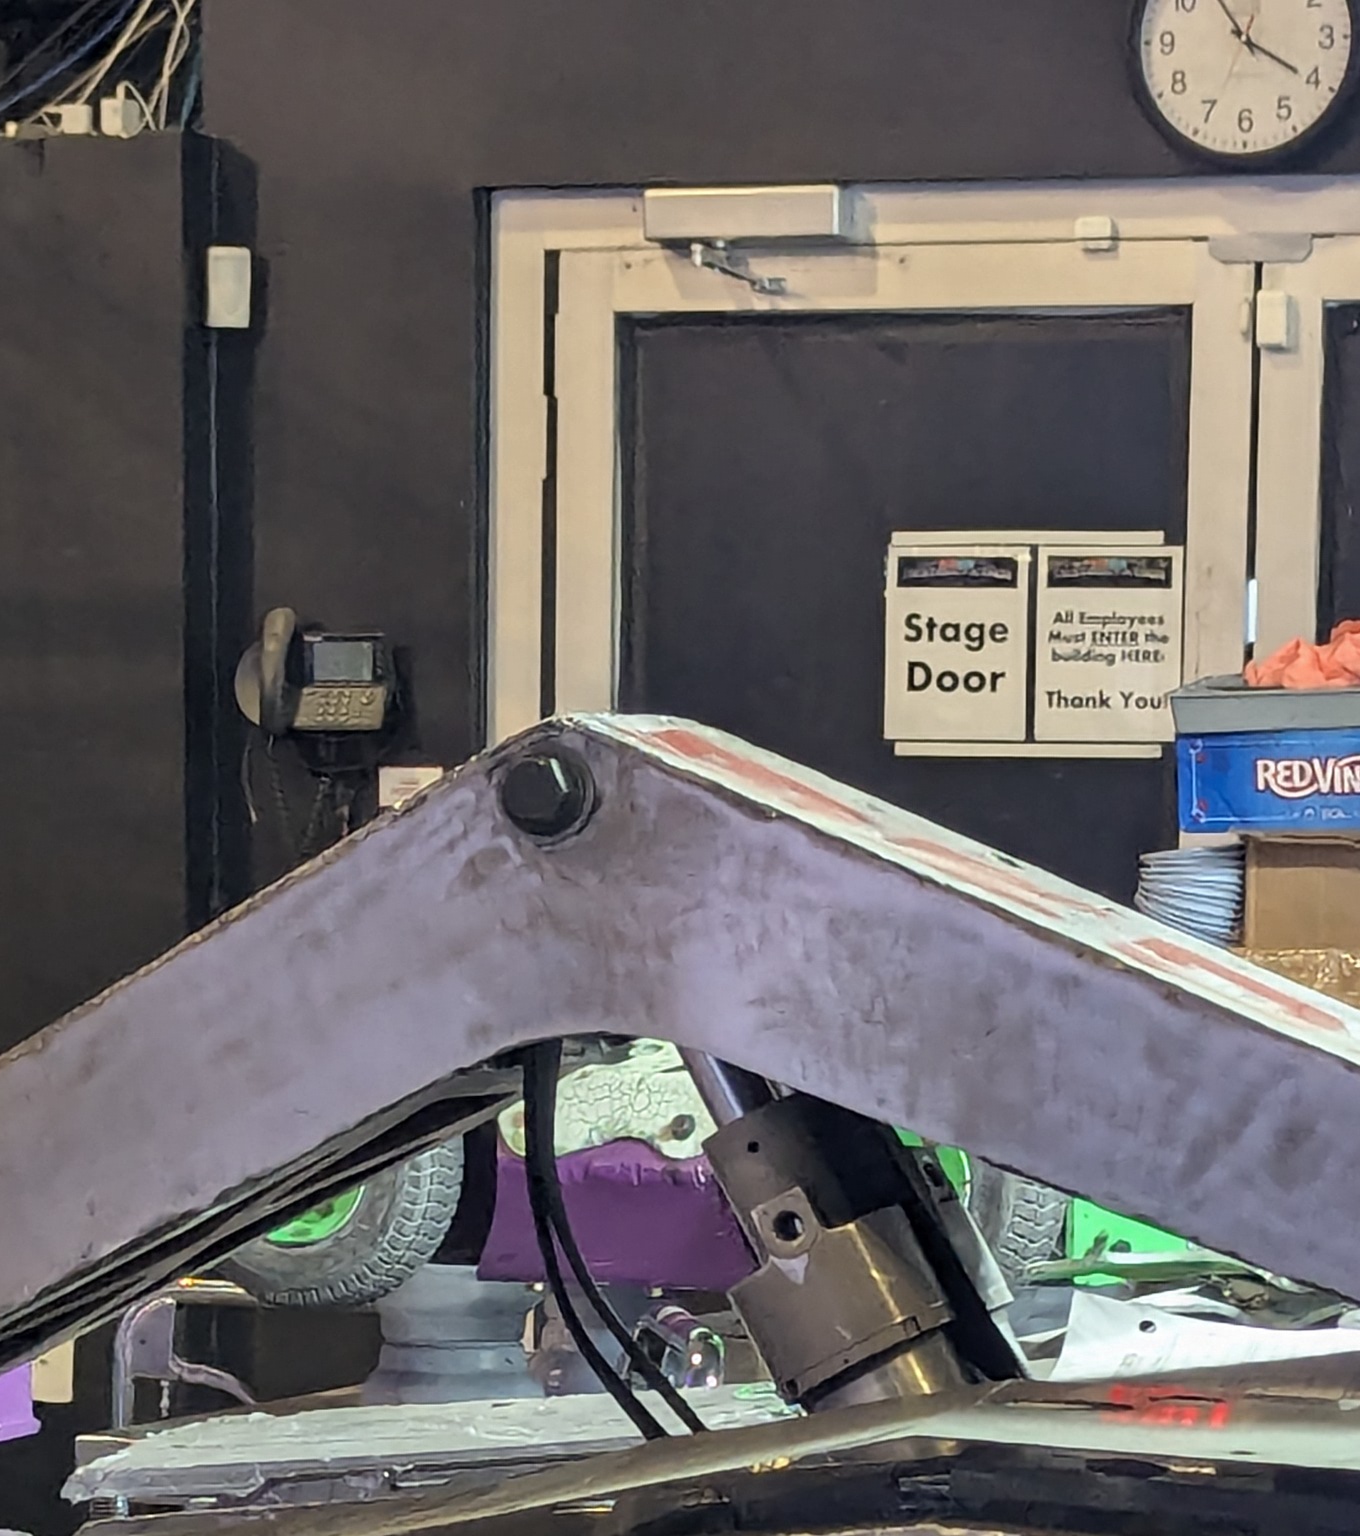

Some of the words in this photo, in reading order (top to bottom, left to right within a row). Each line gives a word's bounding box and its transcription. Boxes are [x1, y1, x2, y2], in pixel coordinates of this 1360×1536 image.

[1159, 31, 1175, 55] 9
[1318, 25, 1335, 50] 3
[1171, 70, 1187, 95] 8
[1305, 66, 1321, 90] 4
[1201, 99, 1217, 123] 7
[1238, 108, 1253, 133] 6
[1276, 96, 1292, 121] 5
[1053, 611, 1073, 625] All
[1079, 611, 1165, 629] Employees
[904, 613, 1009, 652] Stage
[1048, 630, 1086, 643] Must
[1091, 631, 1139, 644] ENTER
[1144, 629, 1169, 644] the
[1051, 648, 1116, 667] building
[907, 661, 1006, 693] Door
[1045, 690, 1111, 709] Thank
